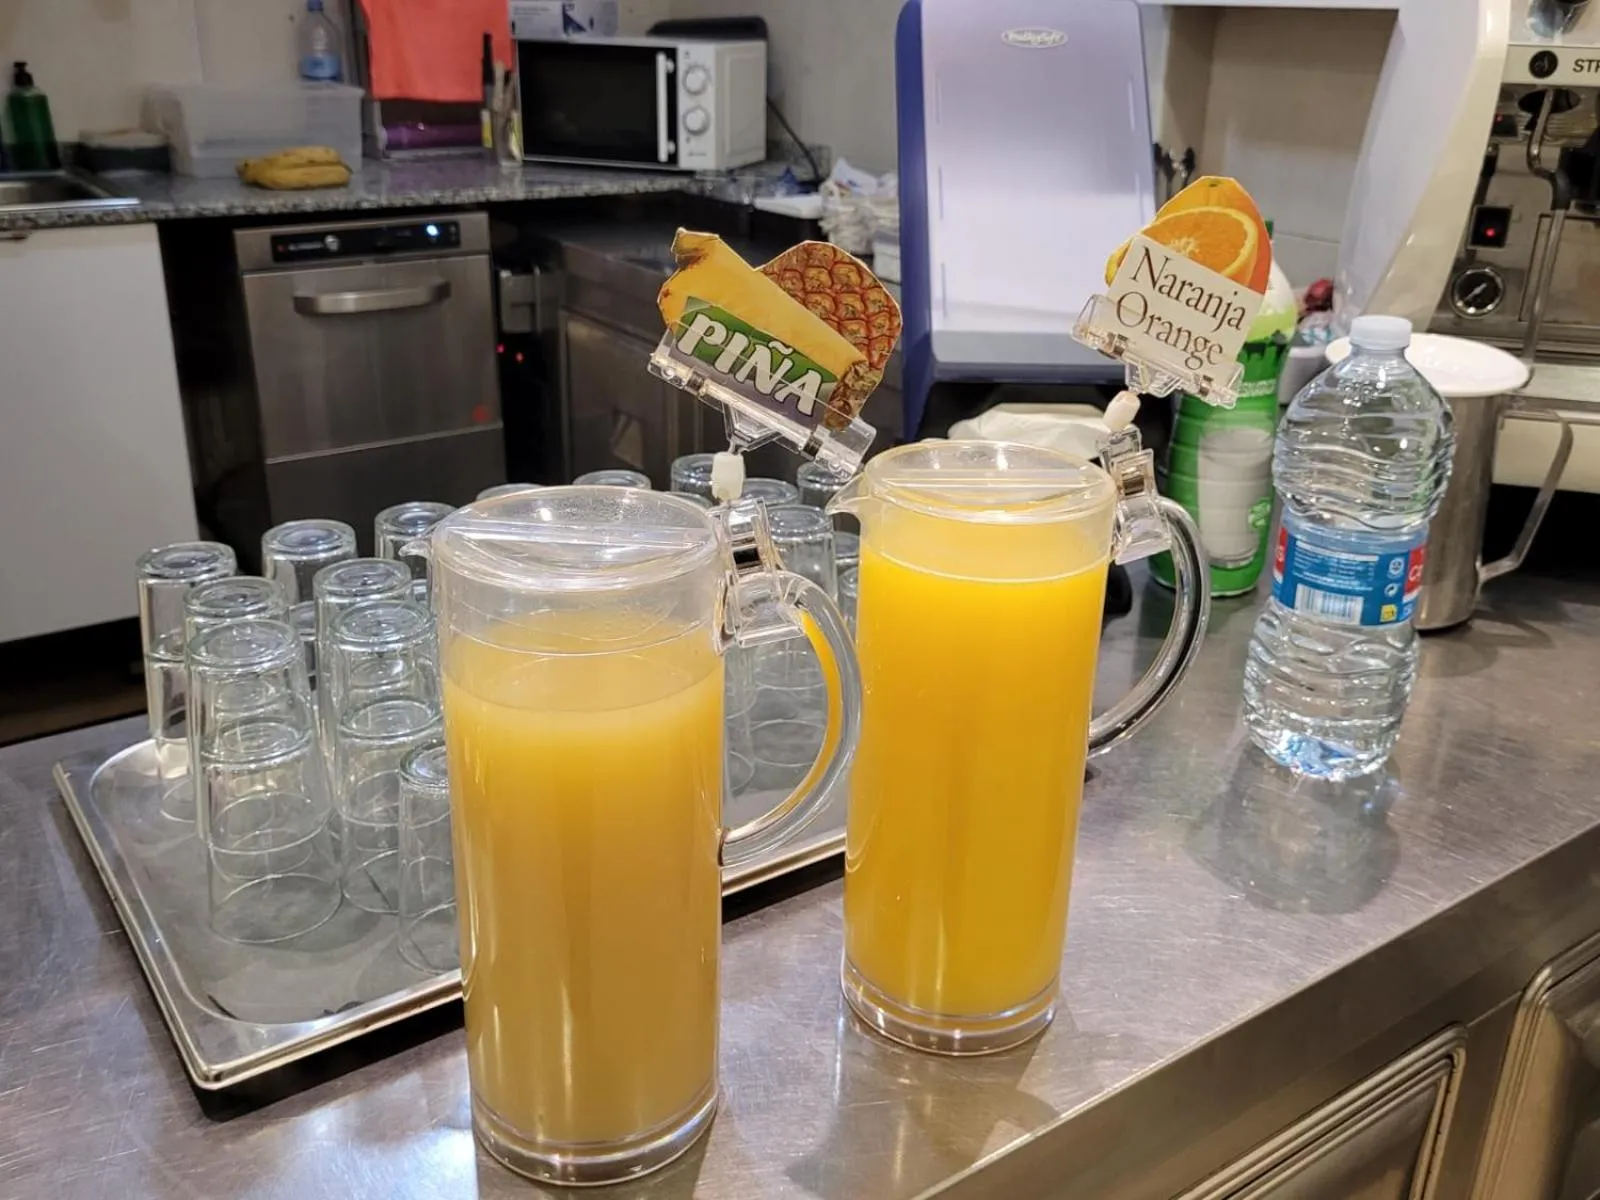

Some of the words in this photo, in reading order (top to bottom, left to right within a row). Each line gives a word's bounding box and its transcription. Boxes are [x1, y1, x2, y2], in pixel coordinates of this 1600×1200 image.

[1116, 291, 1224, 371] Orange
[1129, 245, 1247, 334] Naranja
[677, 313, 822, 417] PIÑA
